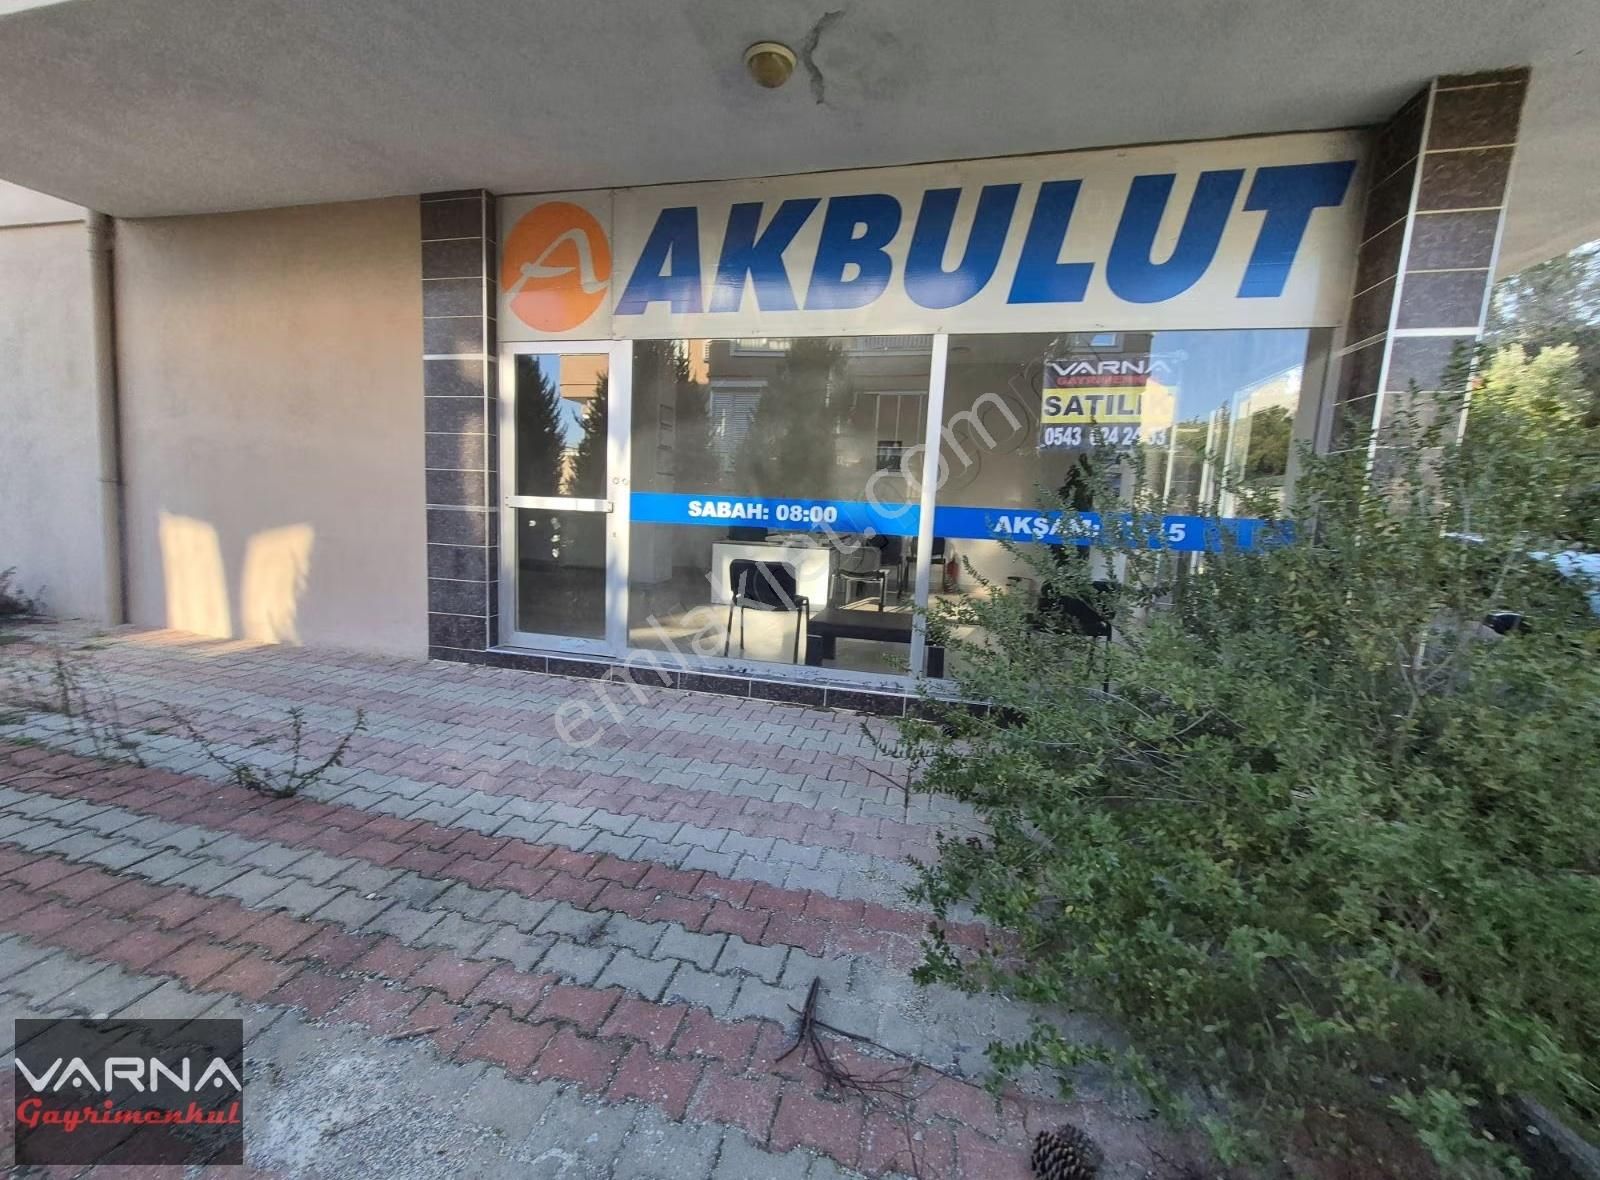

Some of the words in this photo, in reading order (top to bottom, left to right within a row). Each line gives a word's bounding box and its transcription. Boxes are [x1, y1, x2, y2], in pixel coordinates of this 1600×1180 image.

[614, 161, 1355, 315] AKBULUT
[1050, 361, 1171, 375] VARNA
[1044, 427, 1082, 446] 0543
[687, 500, 769, 520] SABAH:
[775, 504, 838, 523] 08:00
